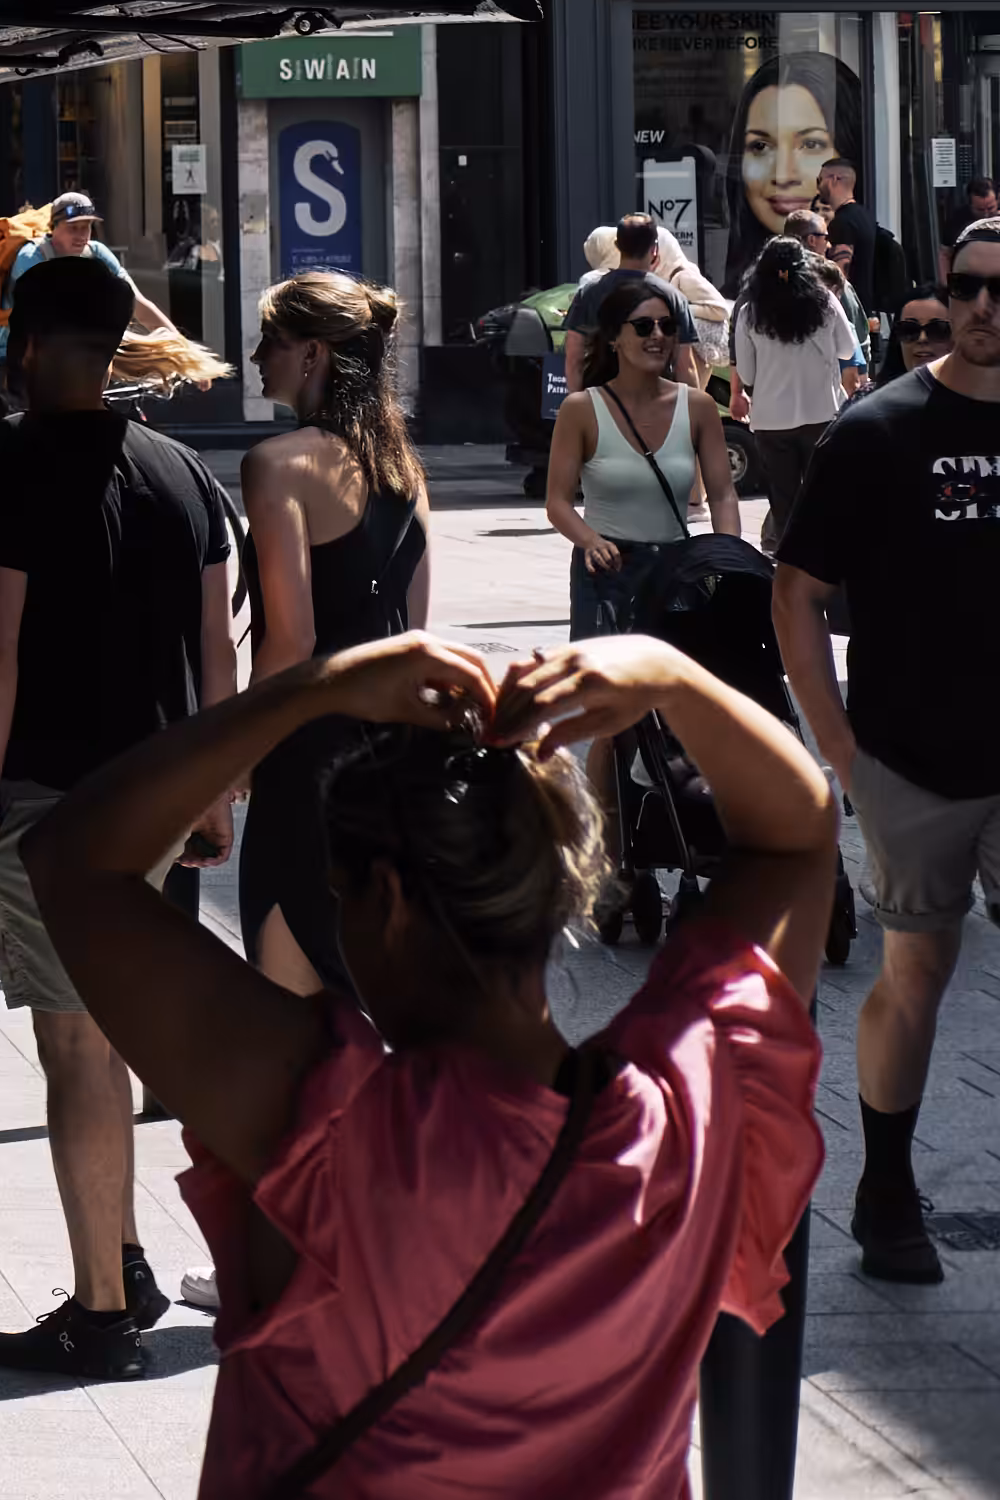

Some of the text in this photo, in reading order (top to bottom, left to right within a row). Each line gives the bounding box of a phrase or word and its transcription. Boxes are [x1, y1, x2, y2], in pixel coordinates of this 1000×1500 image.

[633, 12, 776, 30] EE YOUR SKIN
[279, 58, 376, 80] SWAN
